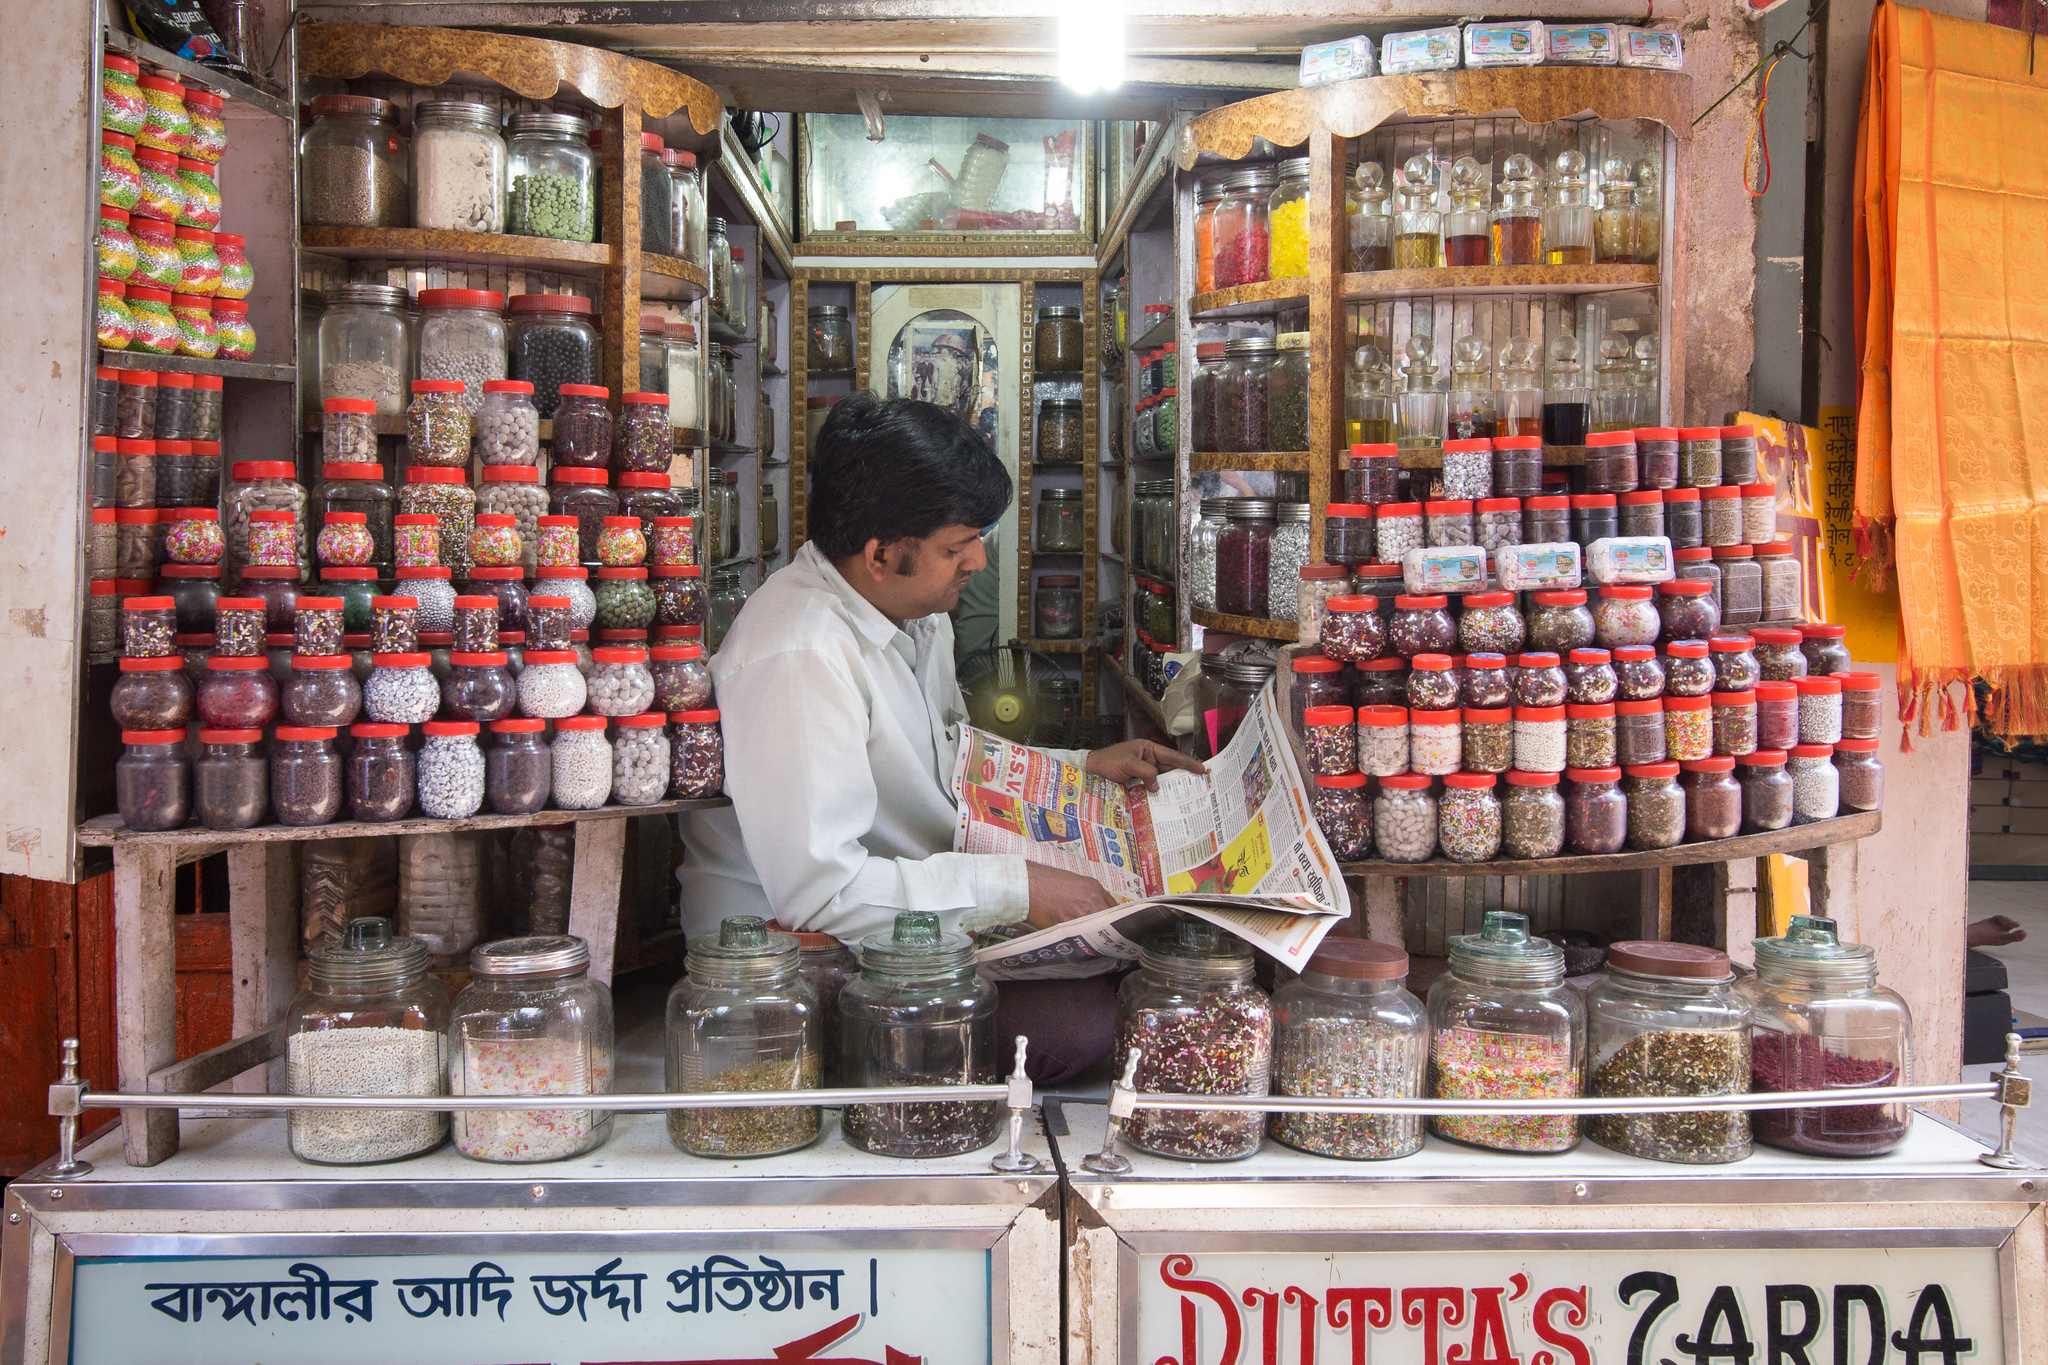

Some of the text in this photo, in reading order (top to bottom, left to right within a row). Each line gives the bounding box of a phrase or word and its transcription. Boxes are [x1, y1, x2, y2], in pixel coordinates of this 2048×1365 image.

[1828, 478, 1854, 499] मीट
[999, 765, 1009, 789] School
[1005, 745, 1026, 794] S.S.V.
[1065, 765, 1077, 793] GOAL
[1293, 840, 1304, 854] तो
[1298, 850, 1312, 872] क्या
[393, 1261, 514, 1322] আদি
[666, 1254, 845, 1313] প্রতিষ্ঠান
[1154, 1254, 1973, 1365] DUTTA'S ZARDA
